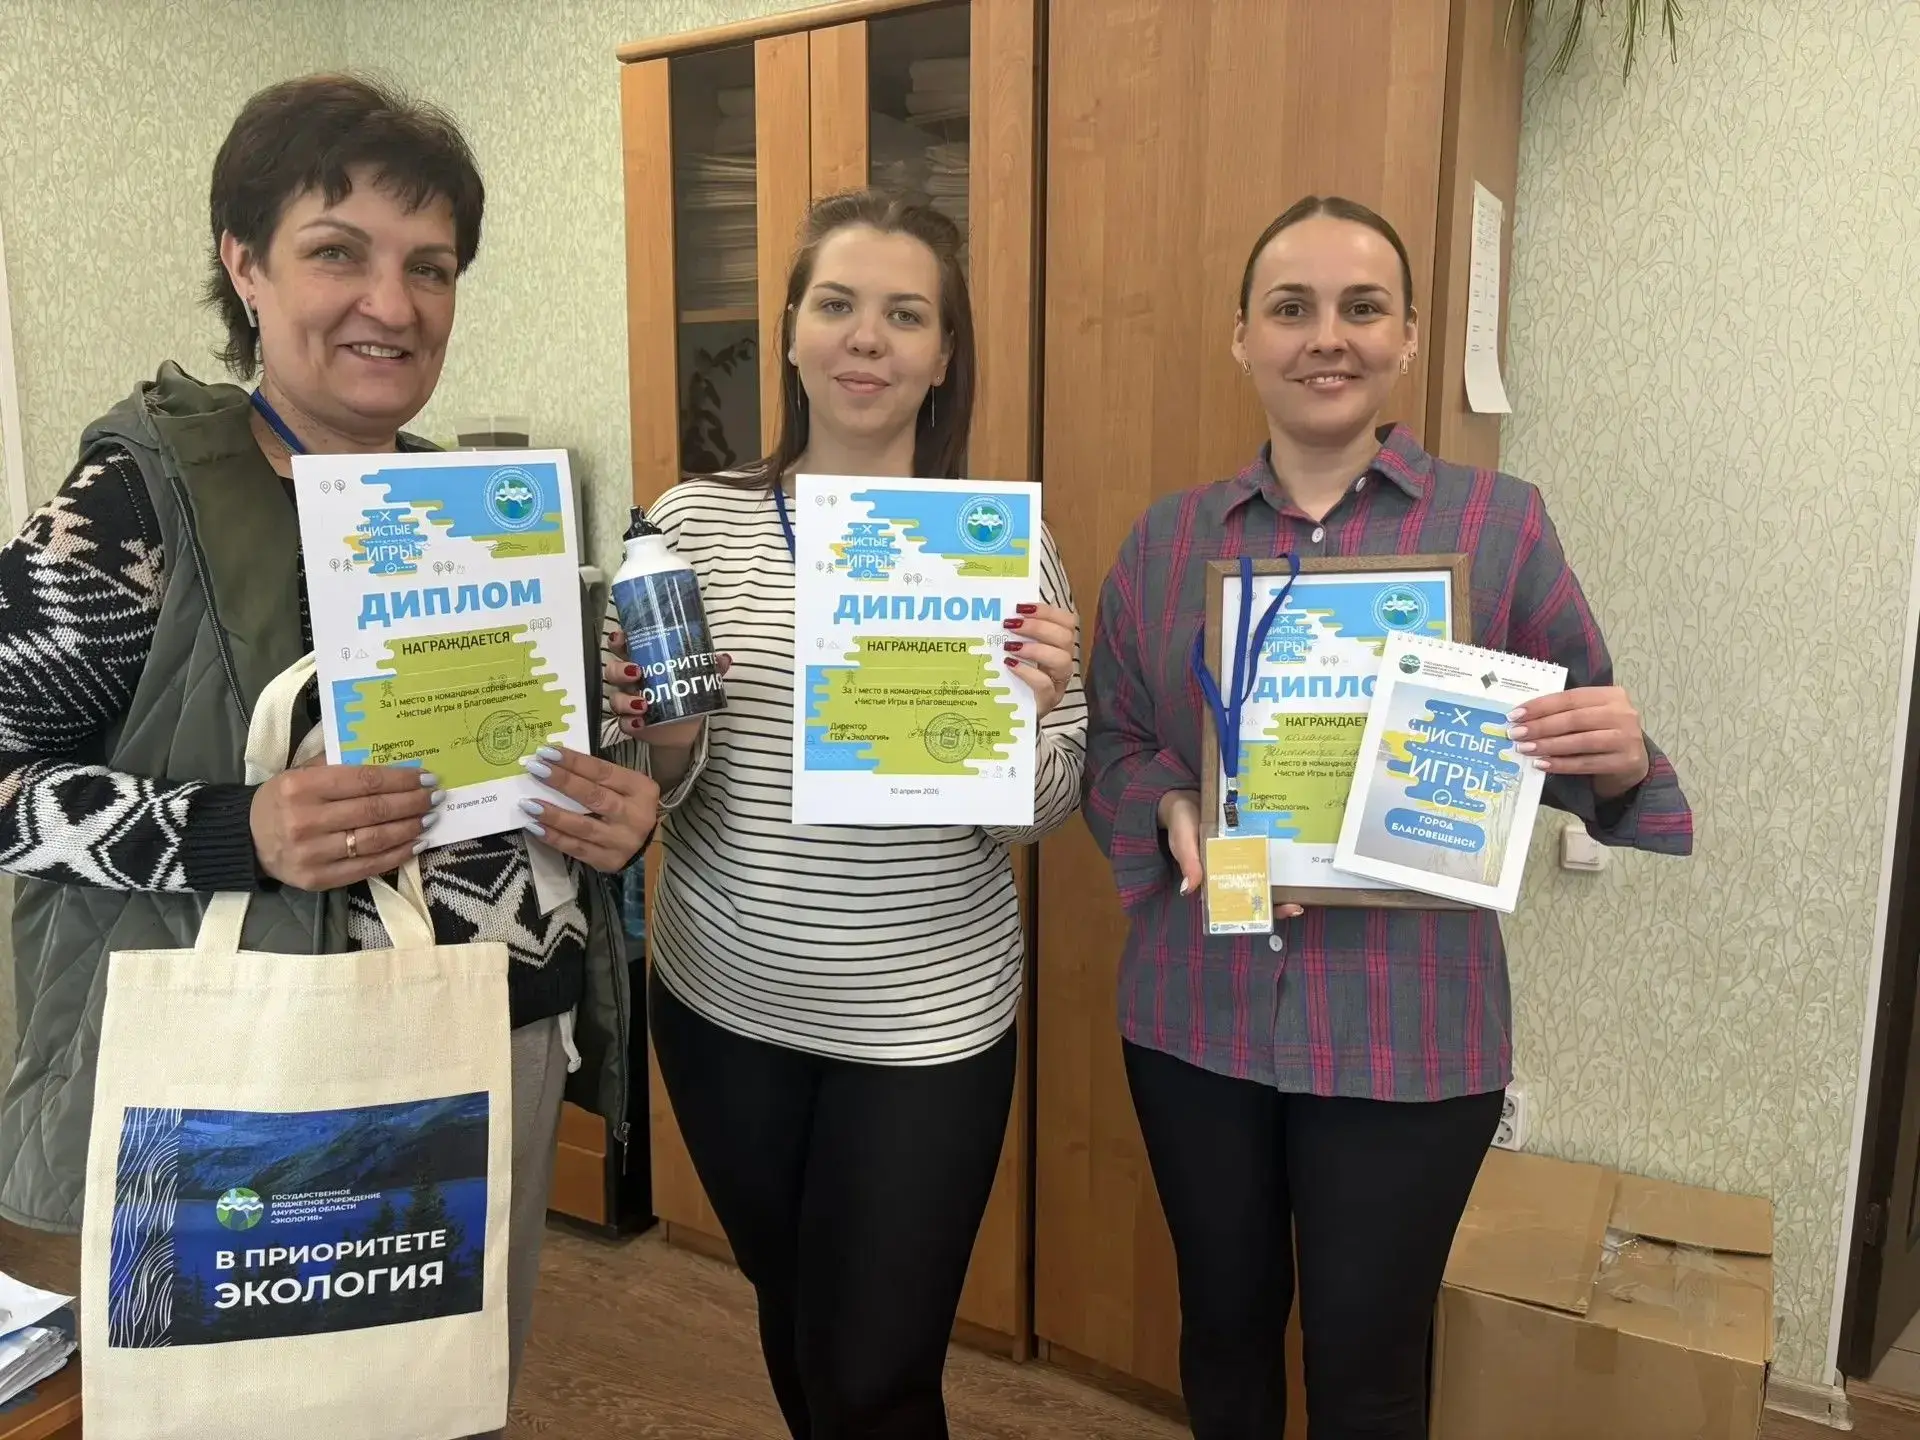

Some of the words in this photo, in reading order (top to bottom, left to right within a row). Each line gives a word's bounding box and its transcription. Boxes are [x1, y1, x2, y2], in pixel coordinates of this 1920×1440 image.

[364, 524, 411, 537] ЧИСТЫЕ
[848, 537, 888, 548] ЧИСТЫЕ
[366, 544, 414, 561] ИГРЫ
[847, 554, 888, 568] ИГРЫ
[357, 578, 542, 630] ДИПЛОМ
[833, 594, 1001, 625] ДИПЛОМ
[402, 631, 510, 655] НАГРАЖДАЕТСЯ
[867, 640, 966, 653] НАГРАЖДАЕТСЯ
[1266, 641, 1304, 653] ИГРЫ
[642, 652, 717, 678] ИОРИТЕТ
[380, 700, 392, 708] За
[399, 696, 425, 705] место
[435, 688, 480, 700] командных
[481, 679, 539, 694] соревнованиях
[641, 673, 723, 705] ОЛОГИЯ
[842, 686, 852, 694] За
[890, 688, 932, 696] командных
[934, 688, 990, 696] соревнованиях
[1253, 675, 1378, 703] ДИПЛО
[396, 707, 432, 718] «Чистые
[434, 703, 455, 714] Игры
[464, 693, 527, 709] Благовещенске»
[887, 698, 908, 706] Игры
[915, 698, 978, 707] Благовещенске»
[830, 722, 867, 731] Директор
[1286, 716, 1367, 728] НАГРАЖДАЕТ
[830, 733, 846, 741] ГБУ
[847, 733, 889, 742] «Экология»
[1419, 724, 1497, 756] ЧИСТЫЕ
[372, 738, 414, 753] Директор
[373, 754, 390, 764] ГБУ
[393, 747, 440, 761] «Экология»
[1309, 760, 1352, 768] командных
[1307, 770, 1327, 778] Игры
[1408, 755, 1490, 793] ИГРЫ
[457, 800, 480, 809] апреля
[481, 794, 498, 804] 2026
[1250, 792, 1287, 801] Директор
[1419, 815, 1454, 831] ГОРОД
[1391, 823, 1476, 849] БЛАГОВЕЩЕНСК
[271, 1199, 324, 1209] БЮДЖЕТНОЕ
[326, 1192, 381, 1204] УЧРЕЖДЕНИЕ
[272, 1188, 351, 1200] ГОСУДАРСТВЕННОЕ
[271, 1206, 317, 1217] АМУРСКОЙ
[318, 1203, 357, 1213] ОБЛАСТИ
[270, 1214, 323, 1225] «ЭКОЛОГИЯ»
[216, 1250, 235, 1270] В
[245, 1229, 447, 1268] ПРИОРИТЕТЕ
[214, 1260, 444, 1309] ЭКОЛОГИЯ
